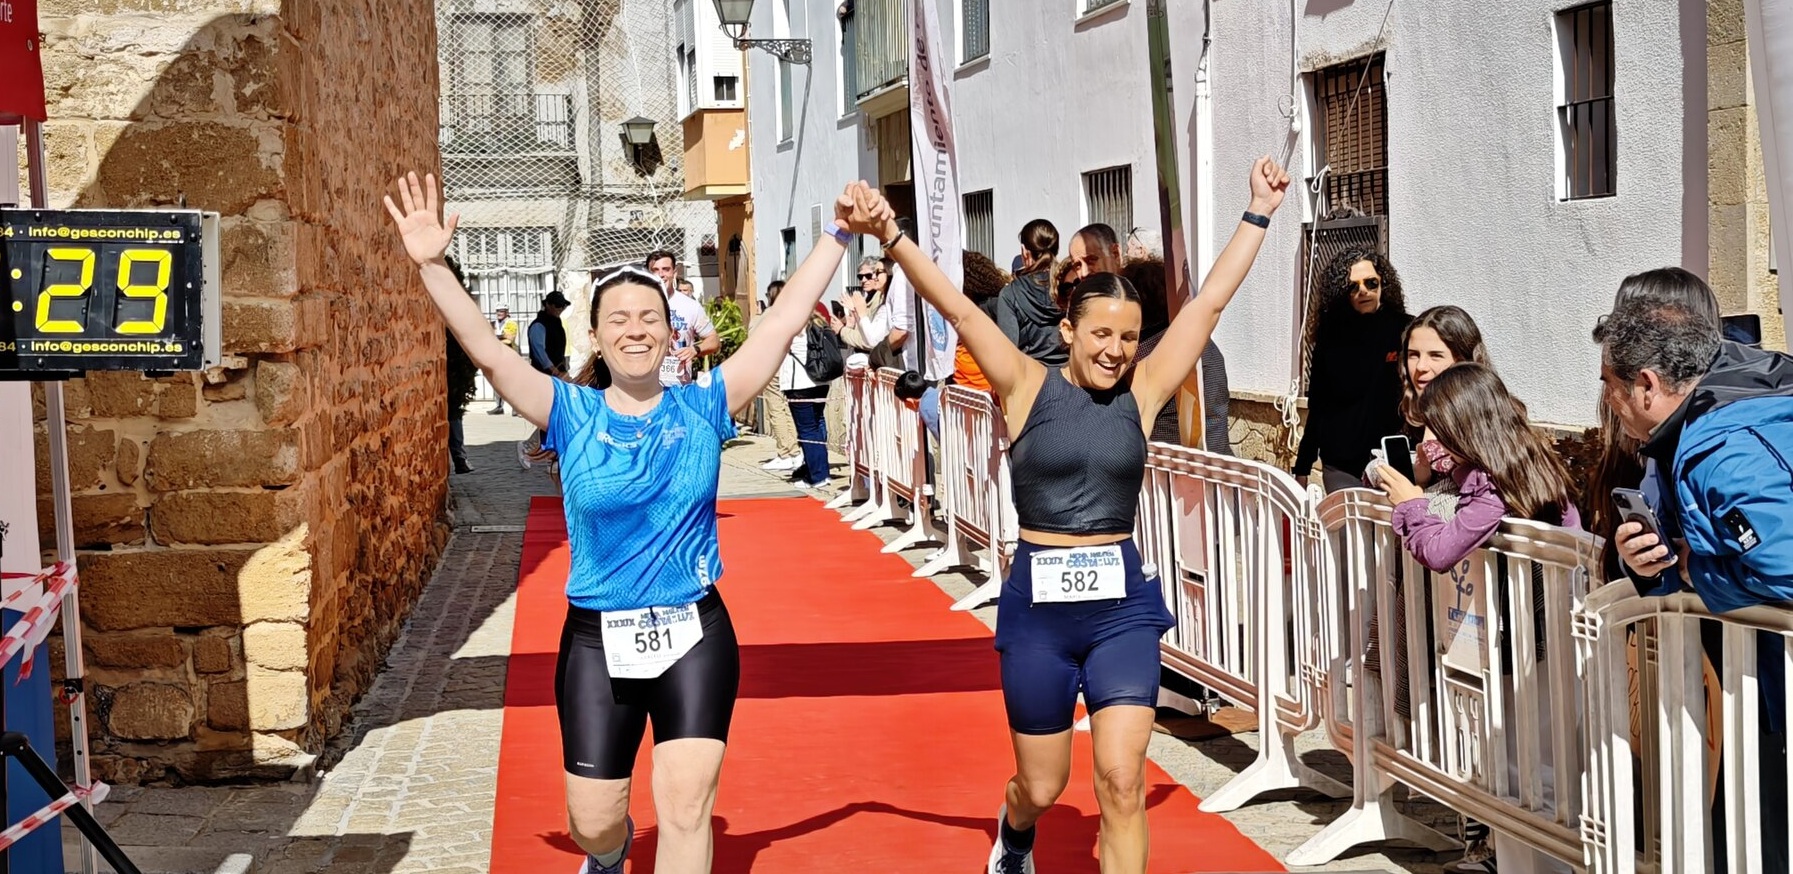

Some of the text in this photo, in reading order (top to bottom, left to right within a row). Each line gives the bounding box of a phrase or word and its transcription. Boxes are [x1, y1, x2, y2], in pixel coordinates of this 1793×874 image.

[916, 38, 928, 72] de
[1066, 557, 1098, 569] COSTA
[1103, 557, 1120, 567] LUZ
[1061, 570, 1099, 593] 582
[634, 627, 673, 654] 581
